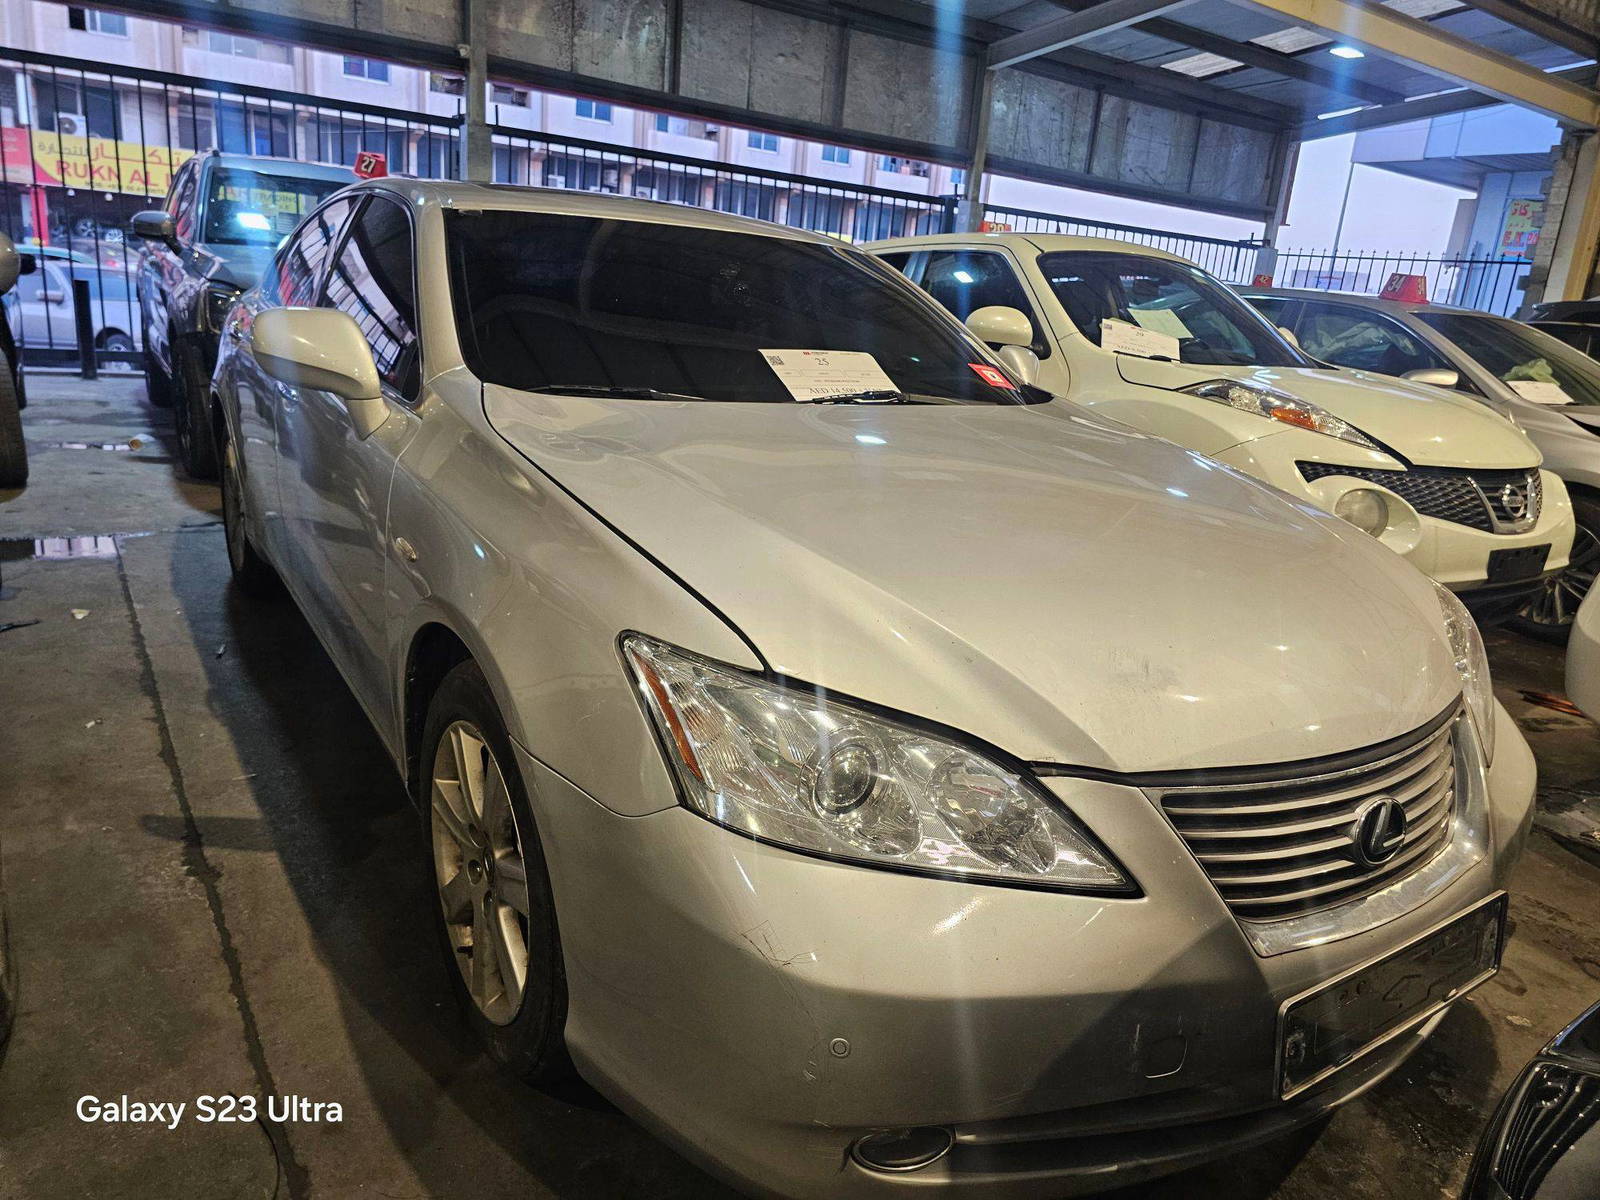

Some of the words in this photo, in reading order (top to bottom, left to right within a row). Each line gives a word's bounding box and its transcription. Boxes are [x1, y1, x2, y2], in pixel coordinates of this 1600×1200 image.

[56, 159, 119, 182] RUKN
[130, 168, 158, 187] AL
[360, 156, 375, 173] 27
[1388, 275, 1405, 292] 34
[815, 357, 830, 366] 25
